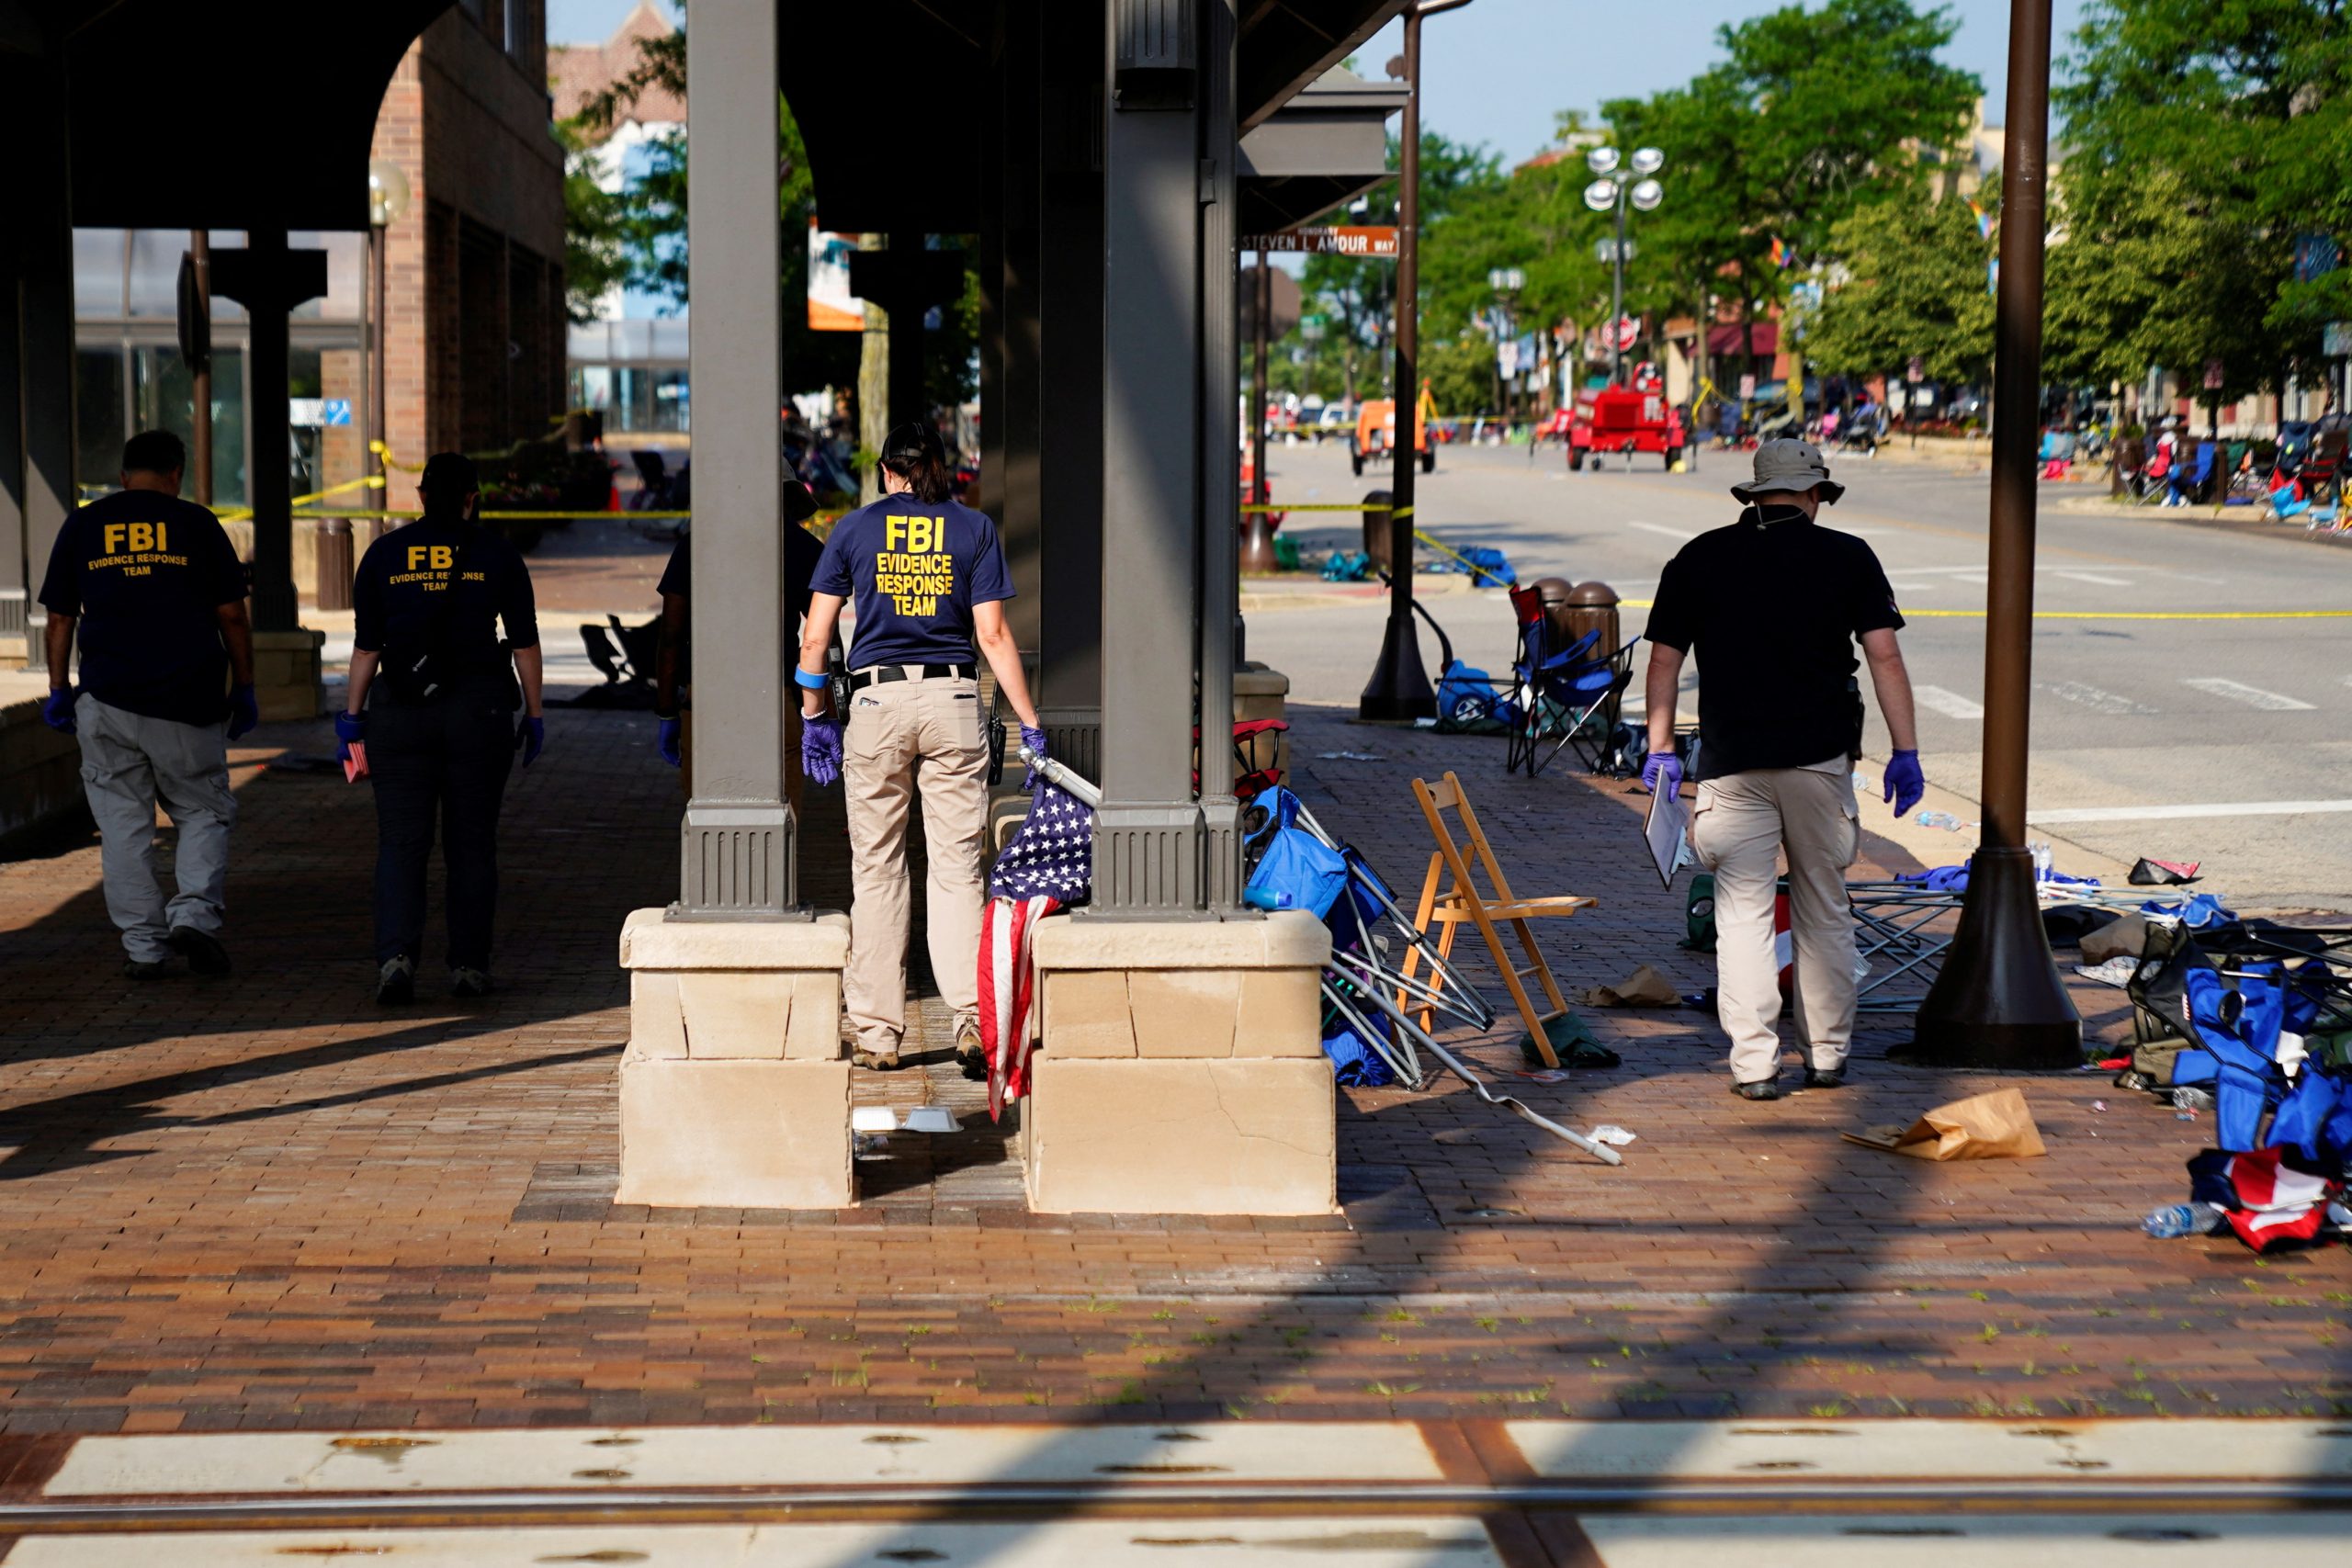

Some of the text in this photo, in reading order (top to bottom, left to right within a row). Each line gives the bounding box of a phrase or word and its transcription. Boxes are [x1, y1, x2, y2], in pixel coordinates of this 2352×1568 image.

[1241, 235, 1296, 252] STEVEN
[1317, 235, 1368, 253] AMOUR
[1374, 240, 1395, 253] WAY
[104, 522, 166, 555] FBI
[886, 514, 944, 554] FBI
[88, 554, 187, 570] EVIDENCE RESPONSE
[407, 545, 459, 570] FB
[876, 552, 953, 574] EVIDENCE
[123, 566, 151, 576] TEAM
[390, 571, 435, 585] EVIDENCE
[876, 573, 954, 596] RESPONSE
[892, 594, 936, 616] TEAM
